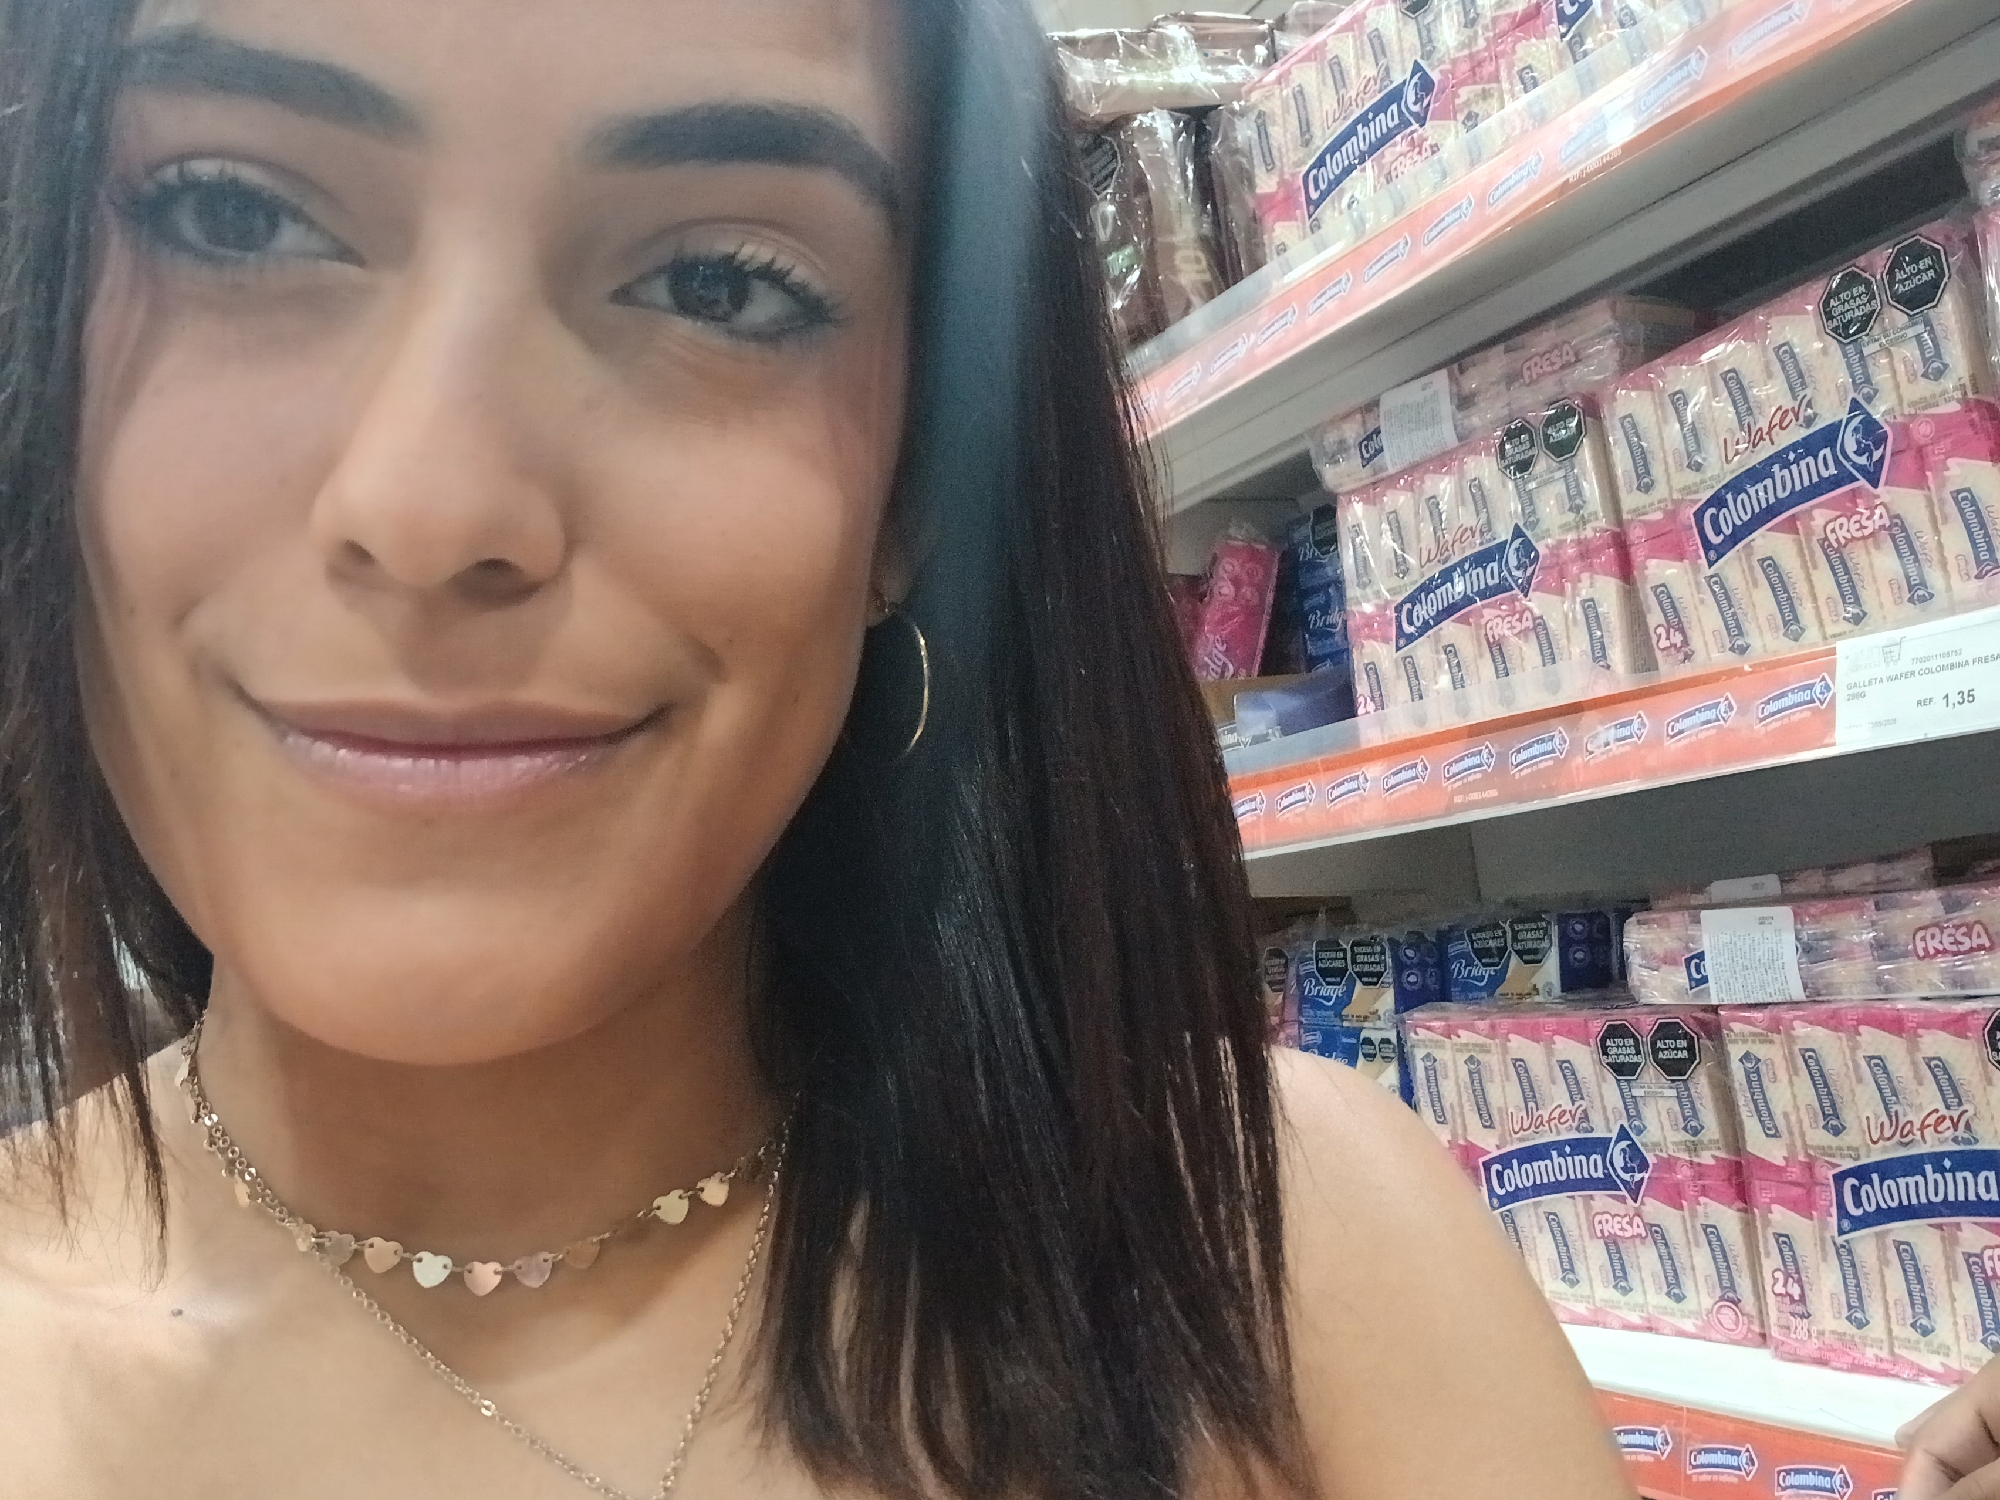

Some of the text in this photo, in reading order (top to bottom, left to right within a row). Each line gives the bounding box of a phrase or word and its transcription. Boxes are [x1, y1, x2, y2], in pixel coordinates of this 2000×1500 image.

[1326, 61, 1389, 130] Wafer
[1308, 102, 1399, 197] Colombina
[1895, 256, 1933, 281] ALTO EN
[1898, 269, 1936, 294] AZÚCAR
[1829, 284, 1866, 308] ALTO EN
[1831, 294, 1868, 316] GRASAS
[1827, 302, 1878, 330] SATURADAS
[1523, 344, 1577, 386] FRESA
[1673, 393, 1697, 450] Colombina
[1723, 401, 1806, 465] Wafer
[1623, 417, 1646, 474] Colombina
[1703, 446, 1838, 545] Colombina
[1825, 504, 1891, 549] FRESA
[1958, 492, 1990, 560] Colombina
[1419, 518, 1482, 569] Wafer
[1891, 519, 1921, 586] Colombina
[1401, 556, 1501, 634] Colombina
[1710, 576, 1738, 637] Colombina
[1762, 559, 1793, 621] Colombina
[1308, 607, 1346, 632] Bridg
[1486, 609, 1534, 642] FRESA
[1583, 601, 1602, 662] Colombina
[1655, 626, 1684, 649] 24
[1846, 652, 2000, 690] GALLETA WAFER COLOMBINA FRESA
[1357, 696, 1376, 715] 24
[1758, 688, 1812, 719] Colombina
[1942, 688, 1976, 709] 1,35
[1667, 708, 1717, 735] Colombina
[1444, 751, 1481, 777] Colombina
[1511, 738, 1553, 765] Colombina
[1328, 779, 1358, 800] Colombina
[1383, 767, 1416, 789] Colombina
[1517, 929, 1544, 940] GRASAS
[1914, 923, 1991, 958] FRESA
[1356, 954, 1379, 962] GRASAS
[1602, 1054, 1643, 1063] SATURADAS
[1605, 1038, 1635, 1047] ALTO EN
[1606, 1046, 1636, 1055] GRASAS
[1656, 1040, 1688, 1049] ALTO EN
[1657, 1049, 1689, 1059] AZÚCAR
[1428, 1070, 1445, 1122] Colombina
[1472, 1072, 1491, 1126] Colombina
[1804, 1051, 1834, 1115] Colombina
[1509, 1103, 1583, 1135] Wafer
[1749, 1072, 1776, 1135] Colombina
[1865, 1107, 1969, 1145] Wafer
[1490, 1144, 1605, 1196] Colombina
[1843, 1157, 2000, 1216] Colombina
[1548, 1214, 1570, 1269] Colombina
[1593, 1213, 1647, 1239] FRESA
[1651, 1227, 1676, 1285] Colombina
[1706, 1227, 1732, 1287] Colombina
[1772, 1269, 1801, 1301] 24
[1899, 1243, 1925, 1314] Colombina
[1968, 1255, 1996, 1329] Colombina
[1789, 1316, 1809, 1341] 288
[1616, 1430, 1654, 1446] olombina
[1690, 1450, 1738, 1466] Colombina
[1779, 1470, 1831, 1488] Colombina
